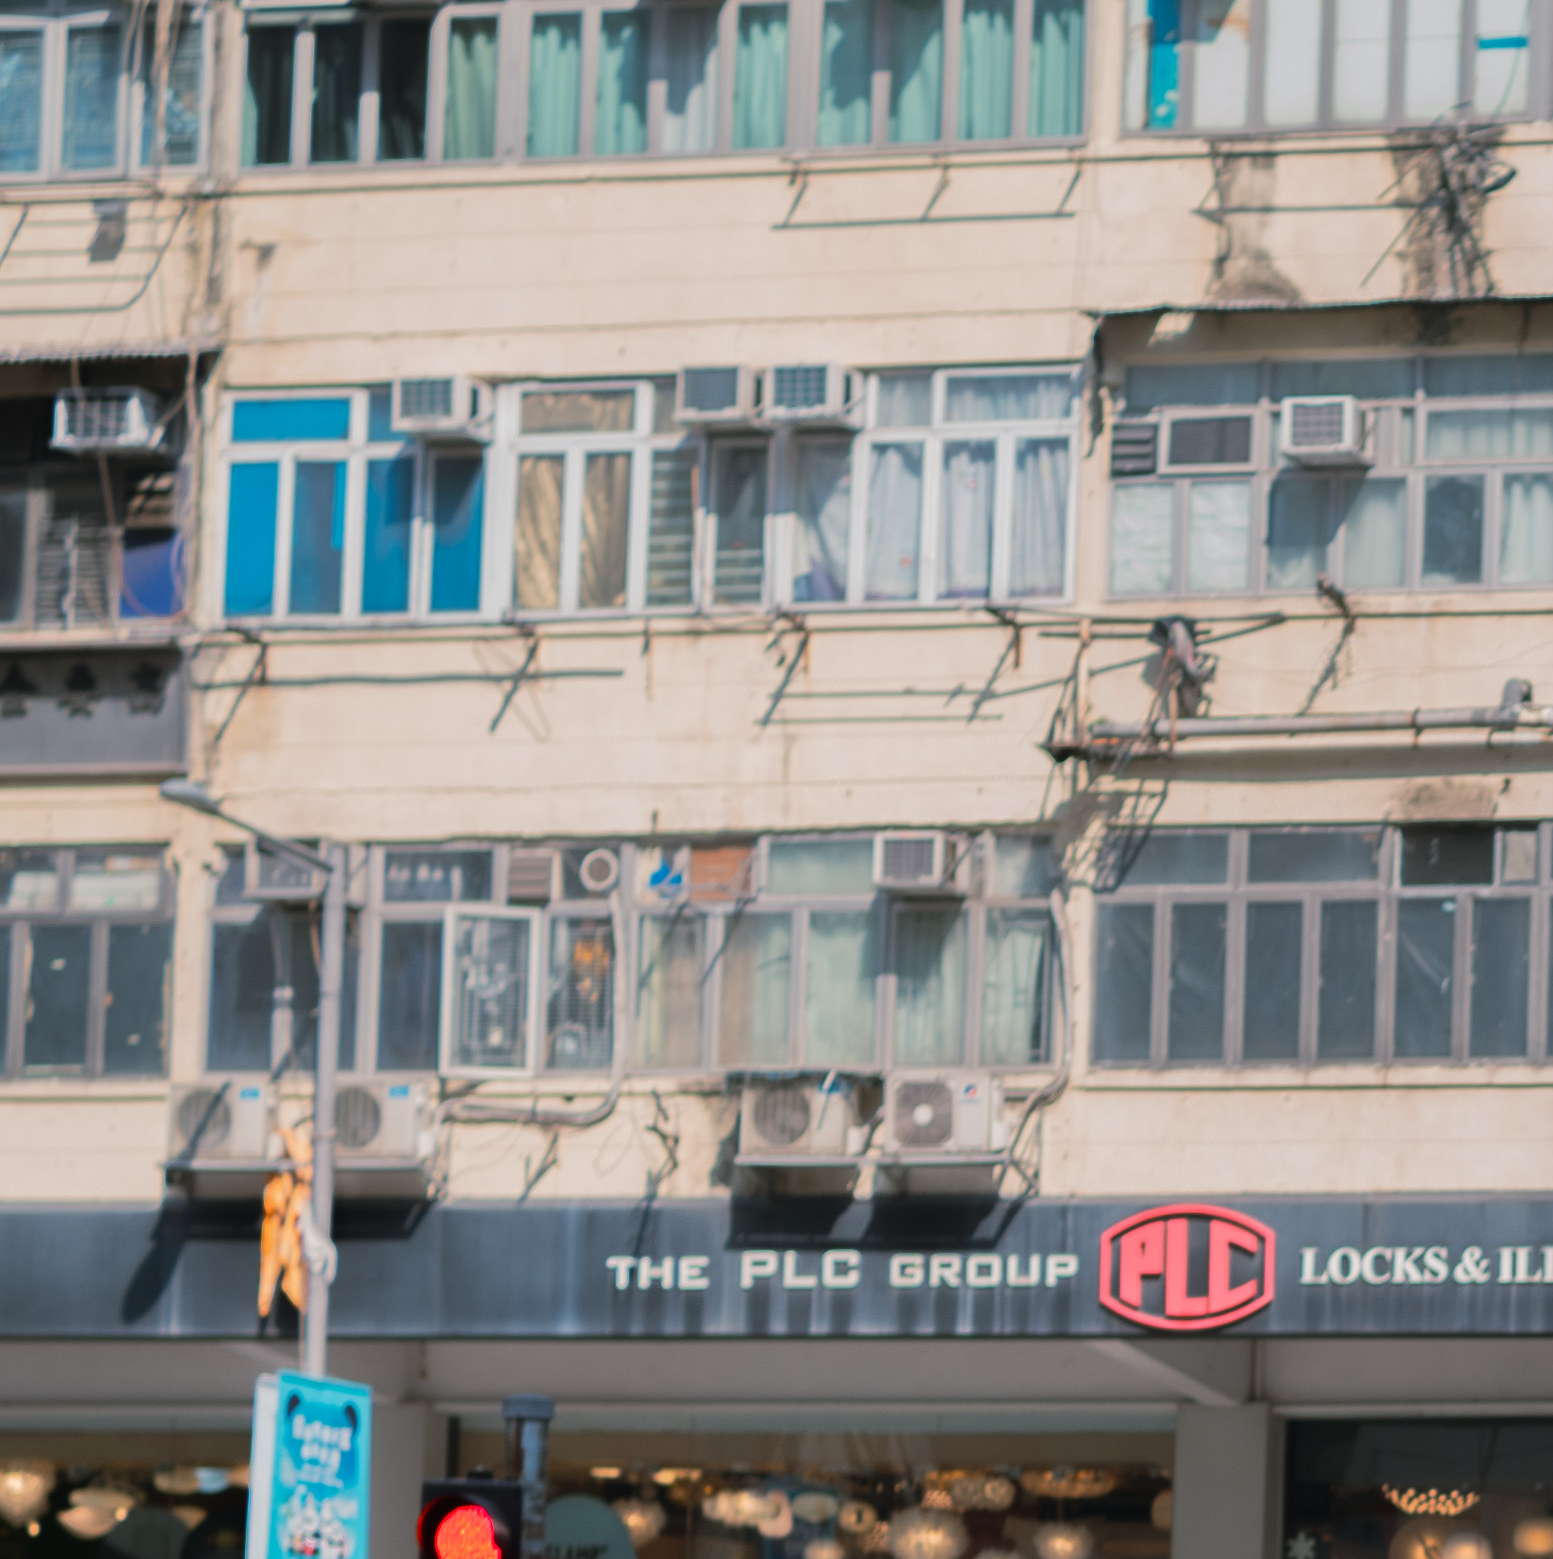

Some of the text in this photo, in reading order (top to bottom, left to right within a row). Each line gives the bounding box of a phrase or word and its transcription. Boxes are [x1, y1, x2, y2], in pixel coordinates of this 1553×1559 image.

[606, 1253, 710, 1291] THE
[740, 1249, 862, 1289] PLC
[889, 1252, 1079, 1289] GROUP
[1117, 1216, 1263, 1321] PLC
[1299, 1245, 1449, 1286] LOCKS
[1452, 1244, 1491, 1286] &
